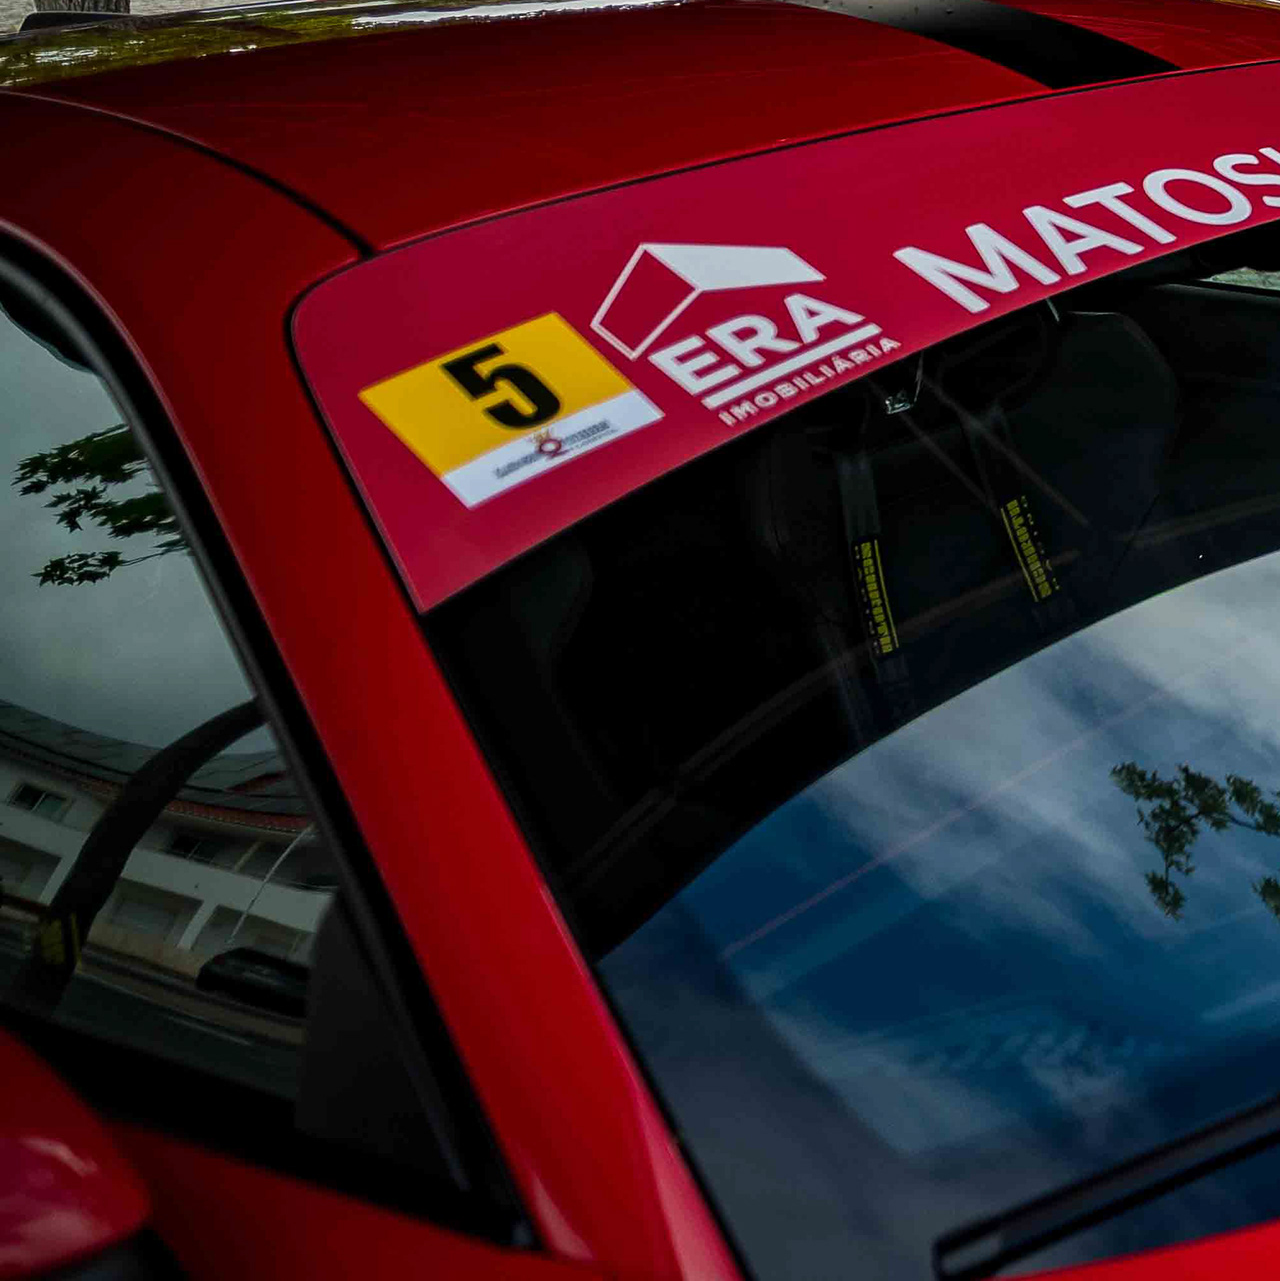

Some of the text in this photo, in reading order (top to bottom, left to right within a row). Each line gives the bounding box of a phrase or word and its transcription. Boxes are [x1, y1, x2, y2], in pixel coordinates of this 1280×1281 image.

[440, 341, 561, 430] 5
[648, 293, 866, 397] ERA
[718, 336, 902, 428] IMOBILIÁRIA
